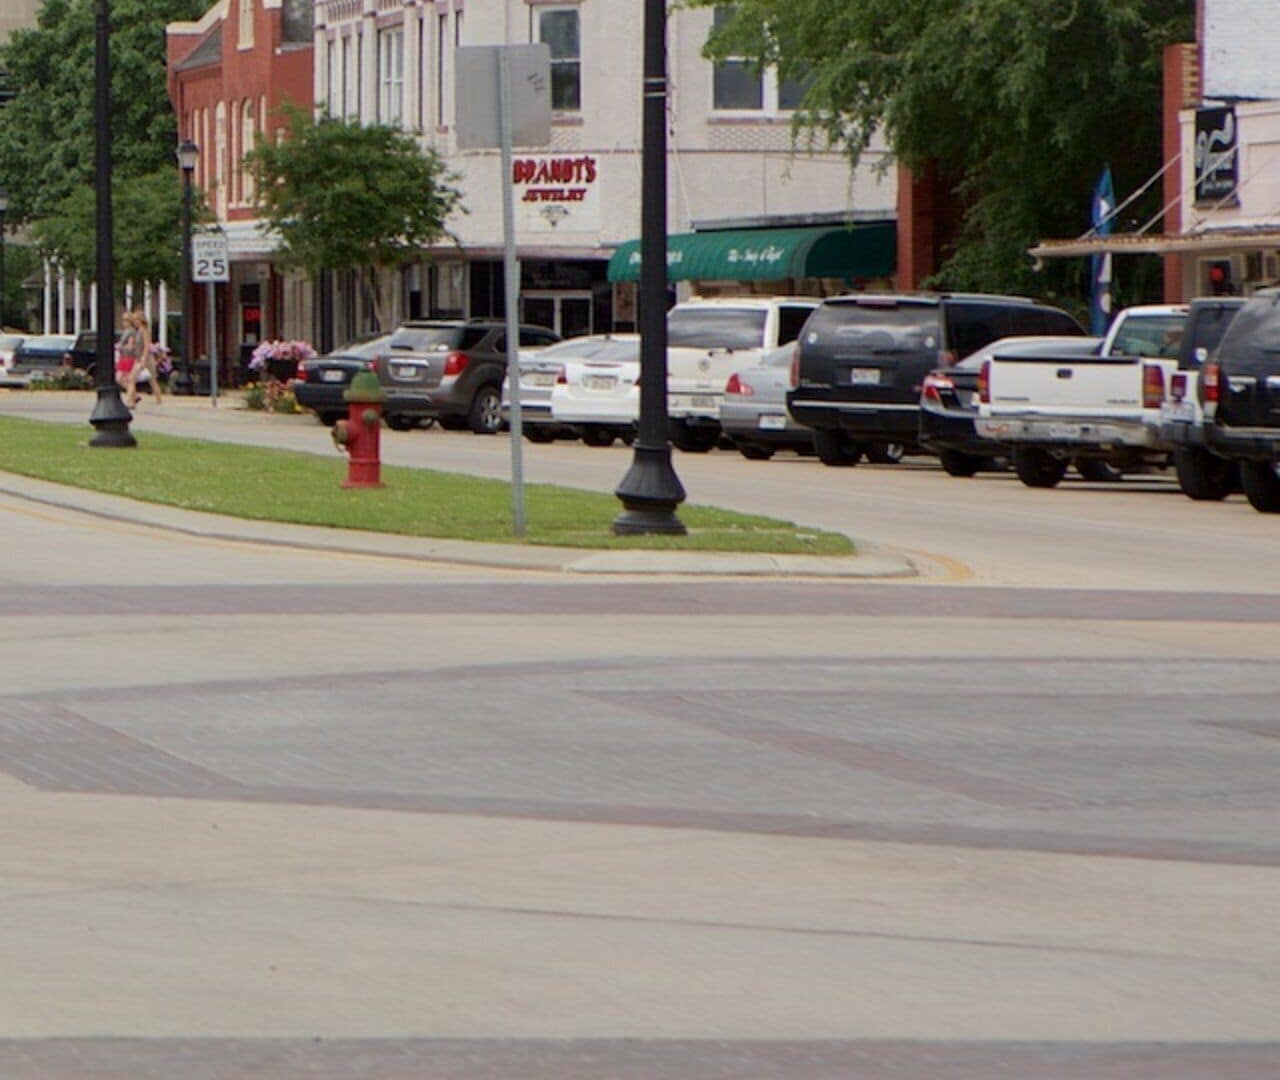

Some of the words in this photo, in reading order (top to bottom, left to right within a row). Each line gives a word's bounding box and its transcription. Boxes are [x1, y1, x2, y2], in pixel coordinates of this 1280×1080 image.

[522, 188, 587, 202] JEWELRY
[195, 240, 226, 249] SPEED
[198, 250, 222, 258] LIMIT
[197, 259, 226, 276] 25
